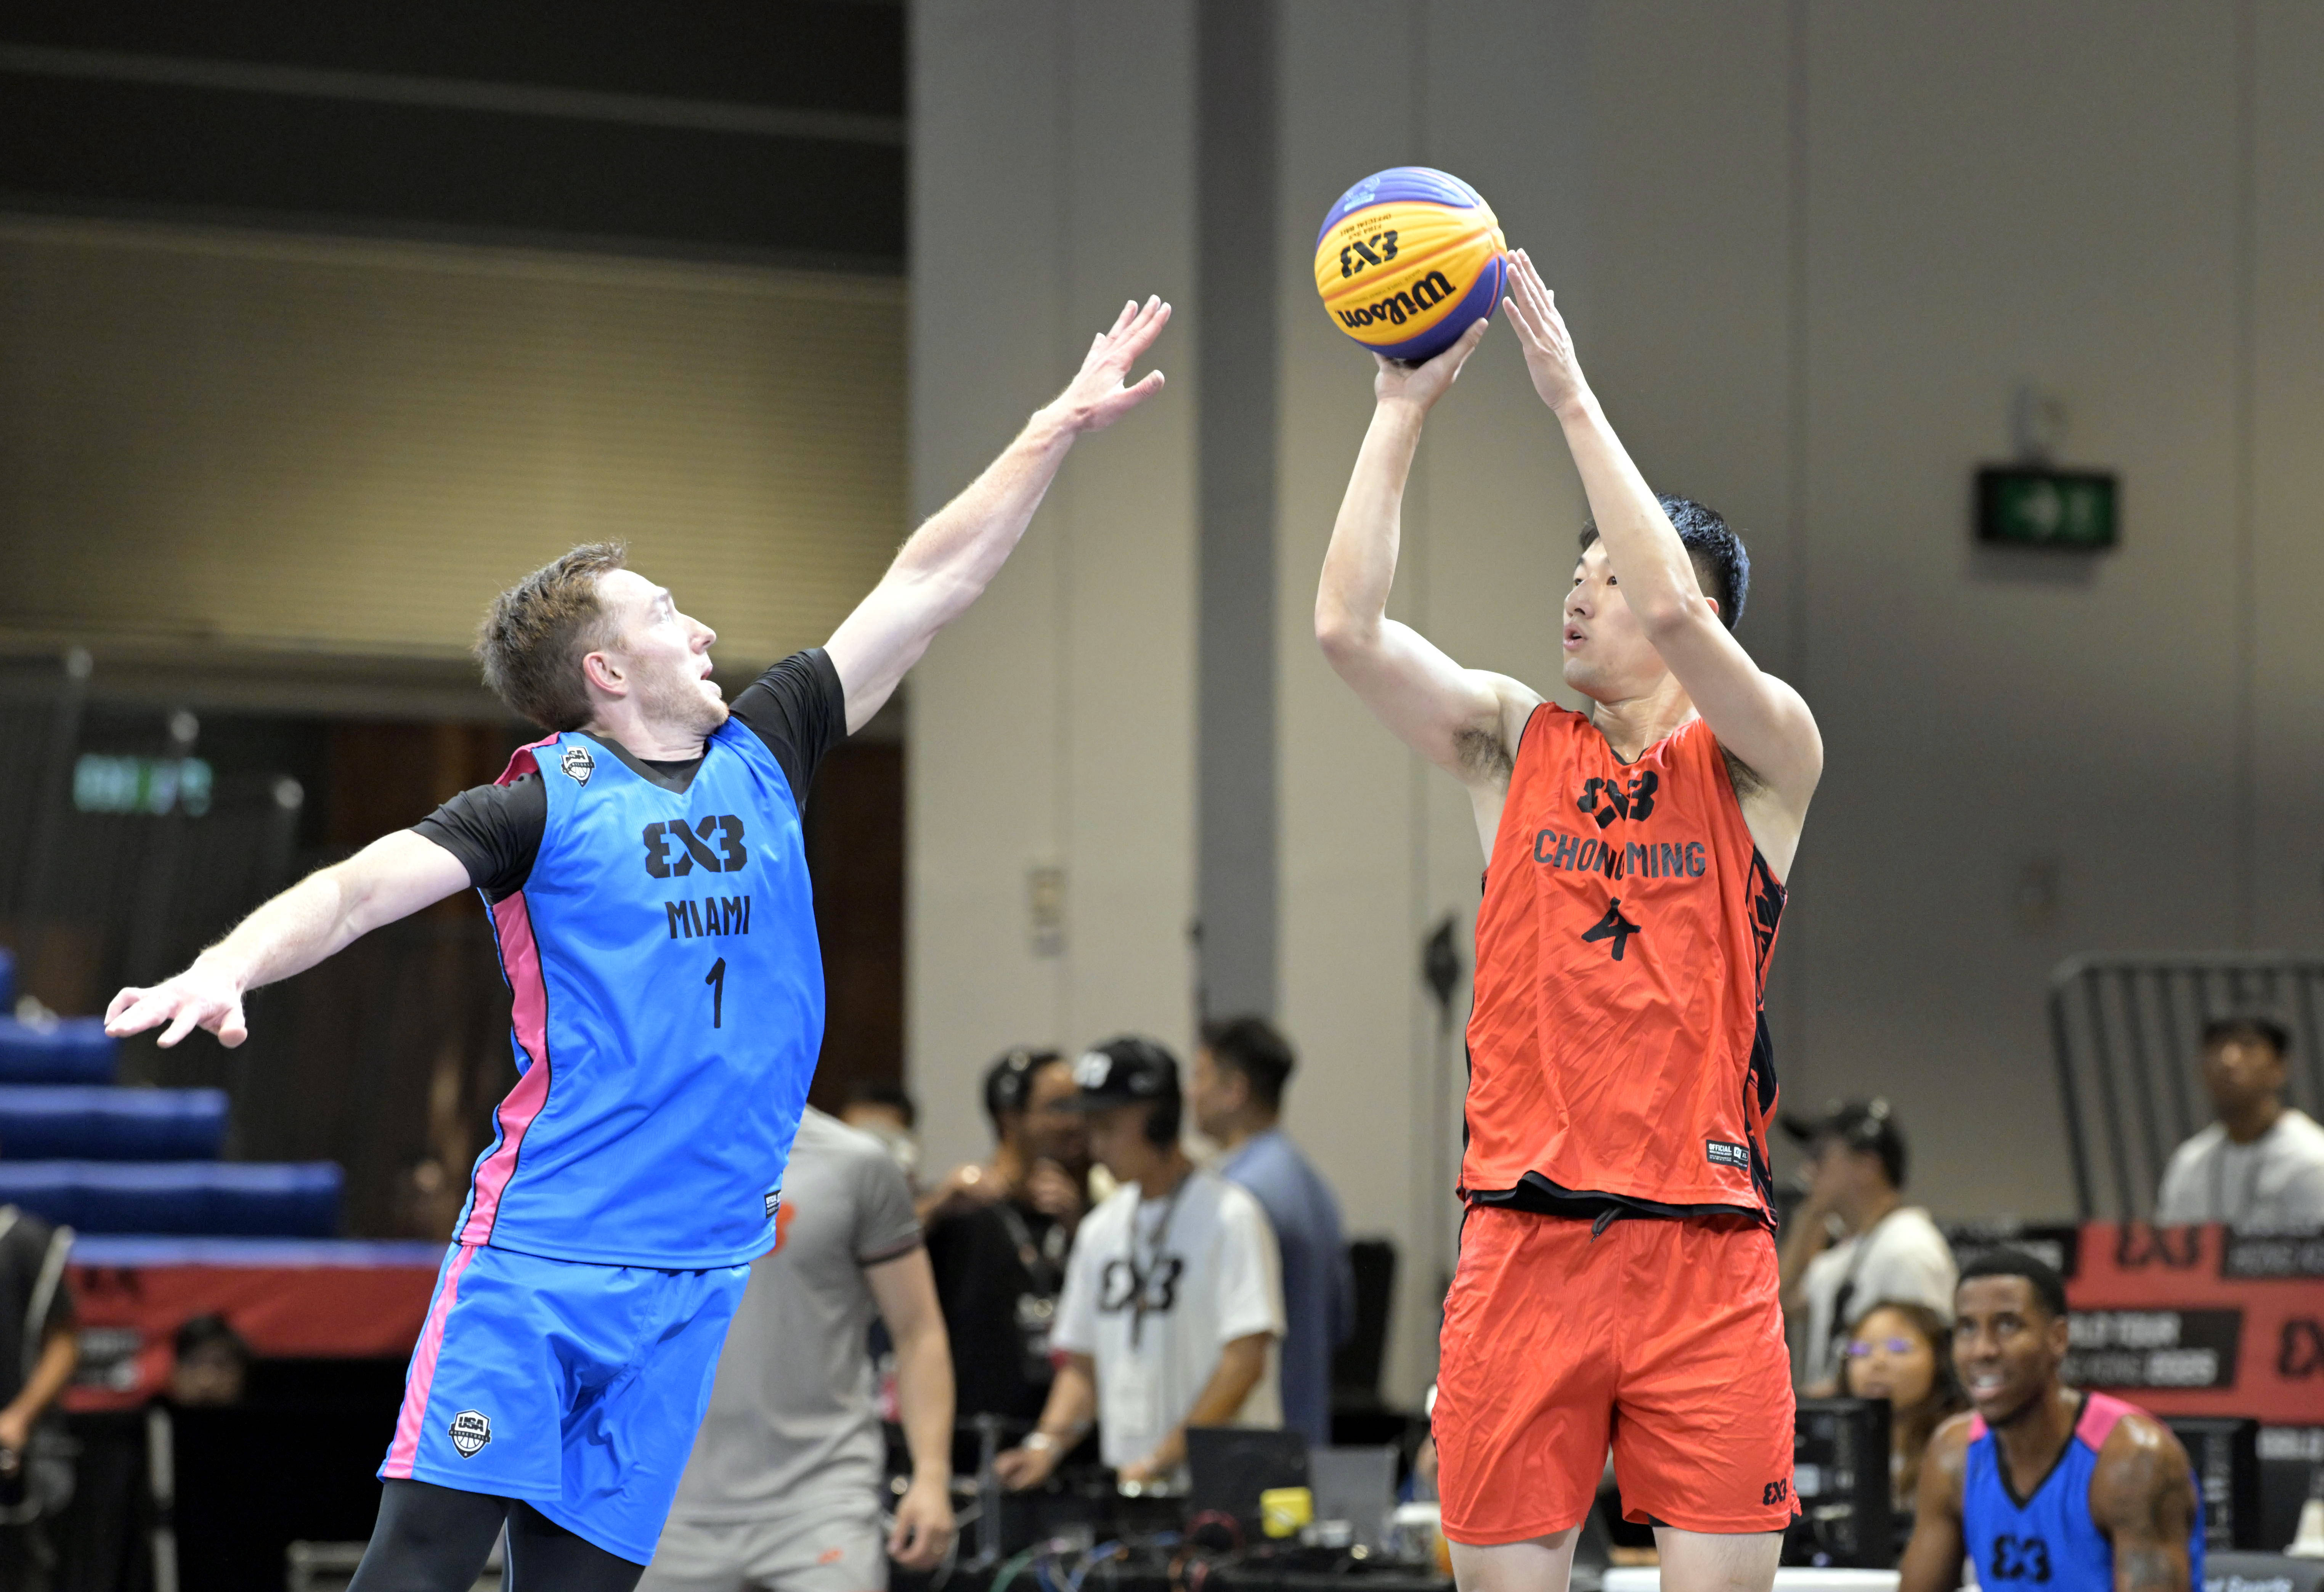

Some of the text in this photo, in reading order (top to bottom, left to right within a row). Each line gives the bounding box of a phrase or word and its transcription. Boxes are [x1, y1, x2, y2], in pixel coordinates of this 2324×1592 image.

[1335, 271, 1457, 328] Wilson
[565, 750, 586, 764] SA
[664, 896, 750, 939] MIAMI
[1581, 897, 1642, 961] 4
[705, 957, 726, 1029] 1
[1709, 1143, 1732, 1152] OFFICIAL
[450, 1430, 488, 1441] BASKETBALL
[458, 1416, 484, 1432] USA
